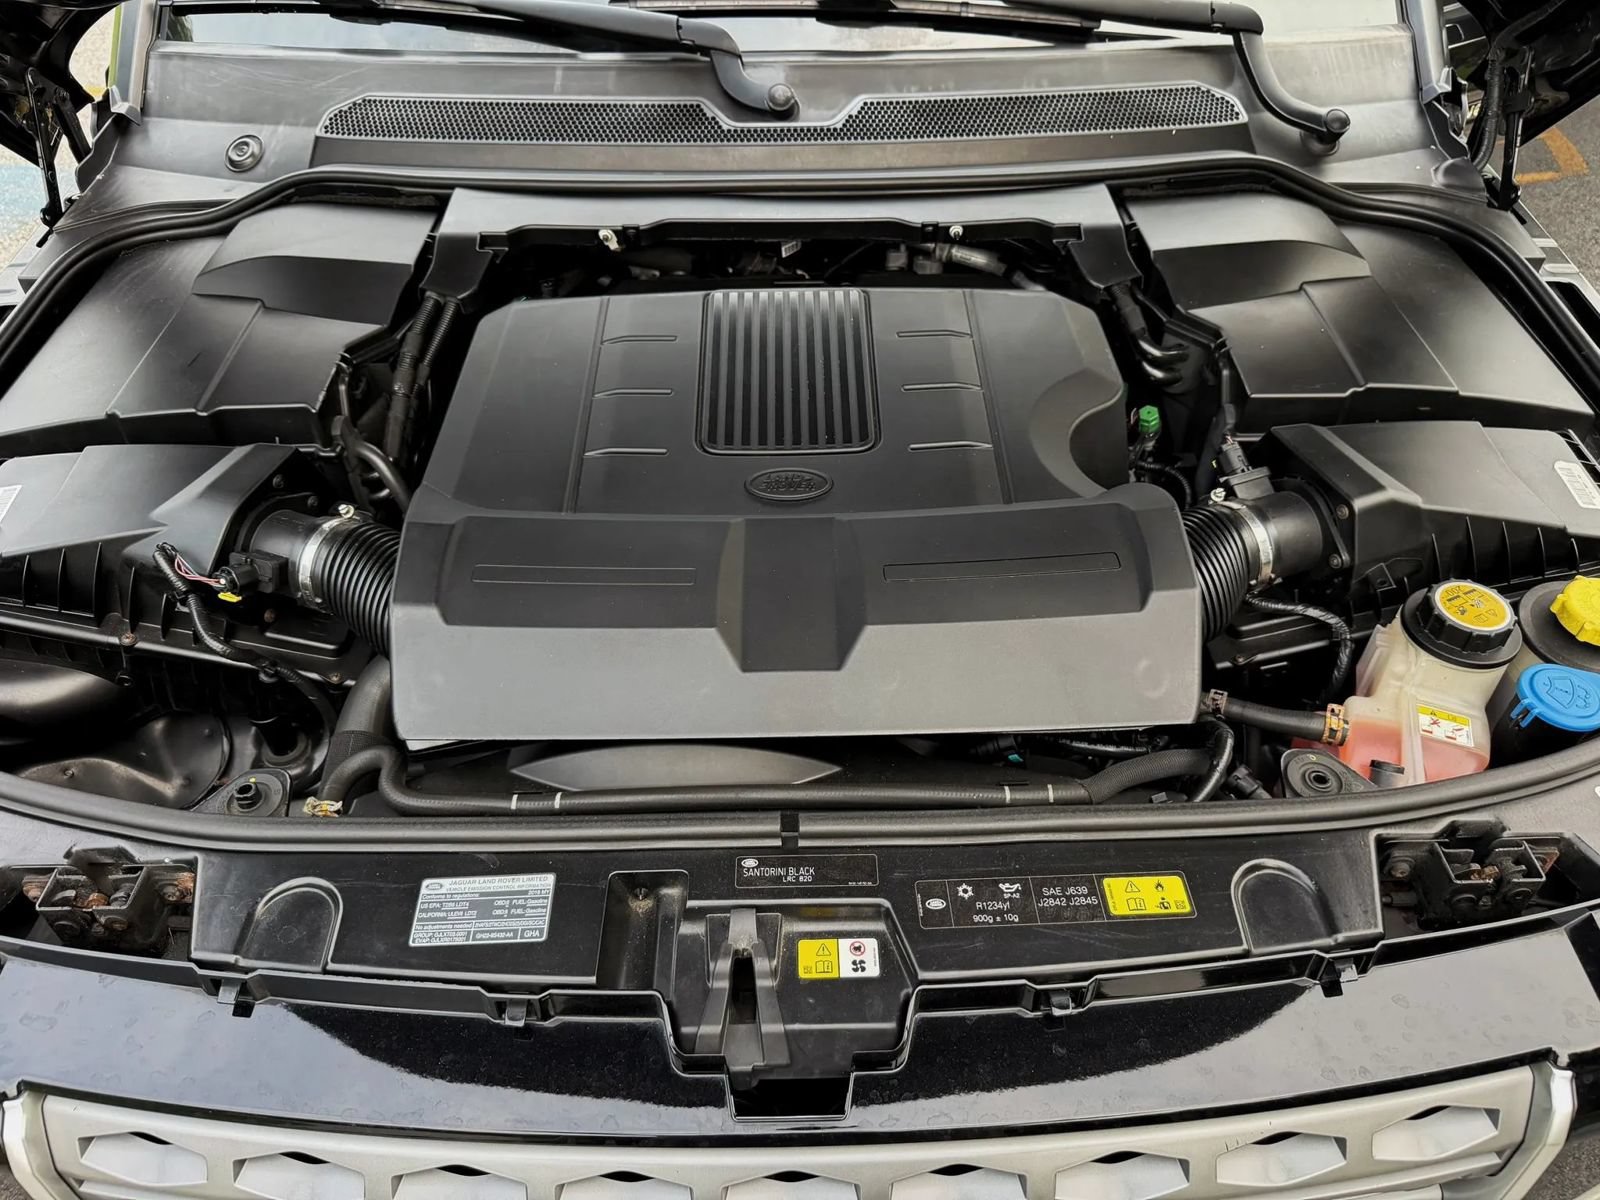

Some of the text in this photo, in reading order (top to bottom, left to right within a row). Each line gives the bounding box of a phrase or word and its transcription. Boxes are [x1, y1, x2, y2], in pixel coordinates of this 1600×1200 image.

[743, 866, 816, 877] SANTORINI BLACK
[1042, 885, 1089, 896] SAE J639
[975, 901, 1010, 911] R1234yf
[1038, 896, 1099, 907] J2842 J2845
[972, 914, 994, 923] 900g
[1004, 913, 1019, 922] 10g
[523, 929, 540, 938] GHA
